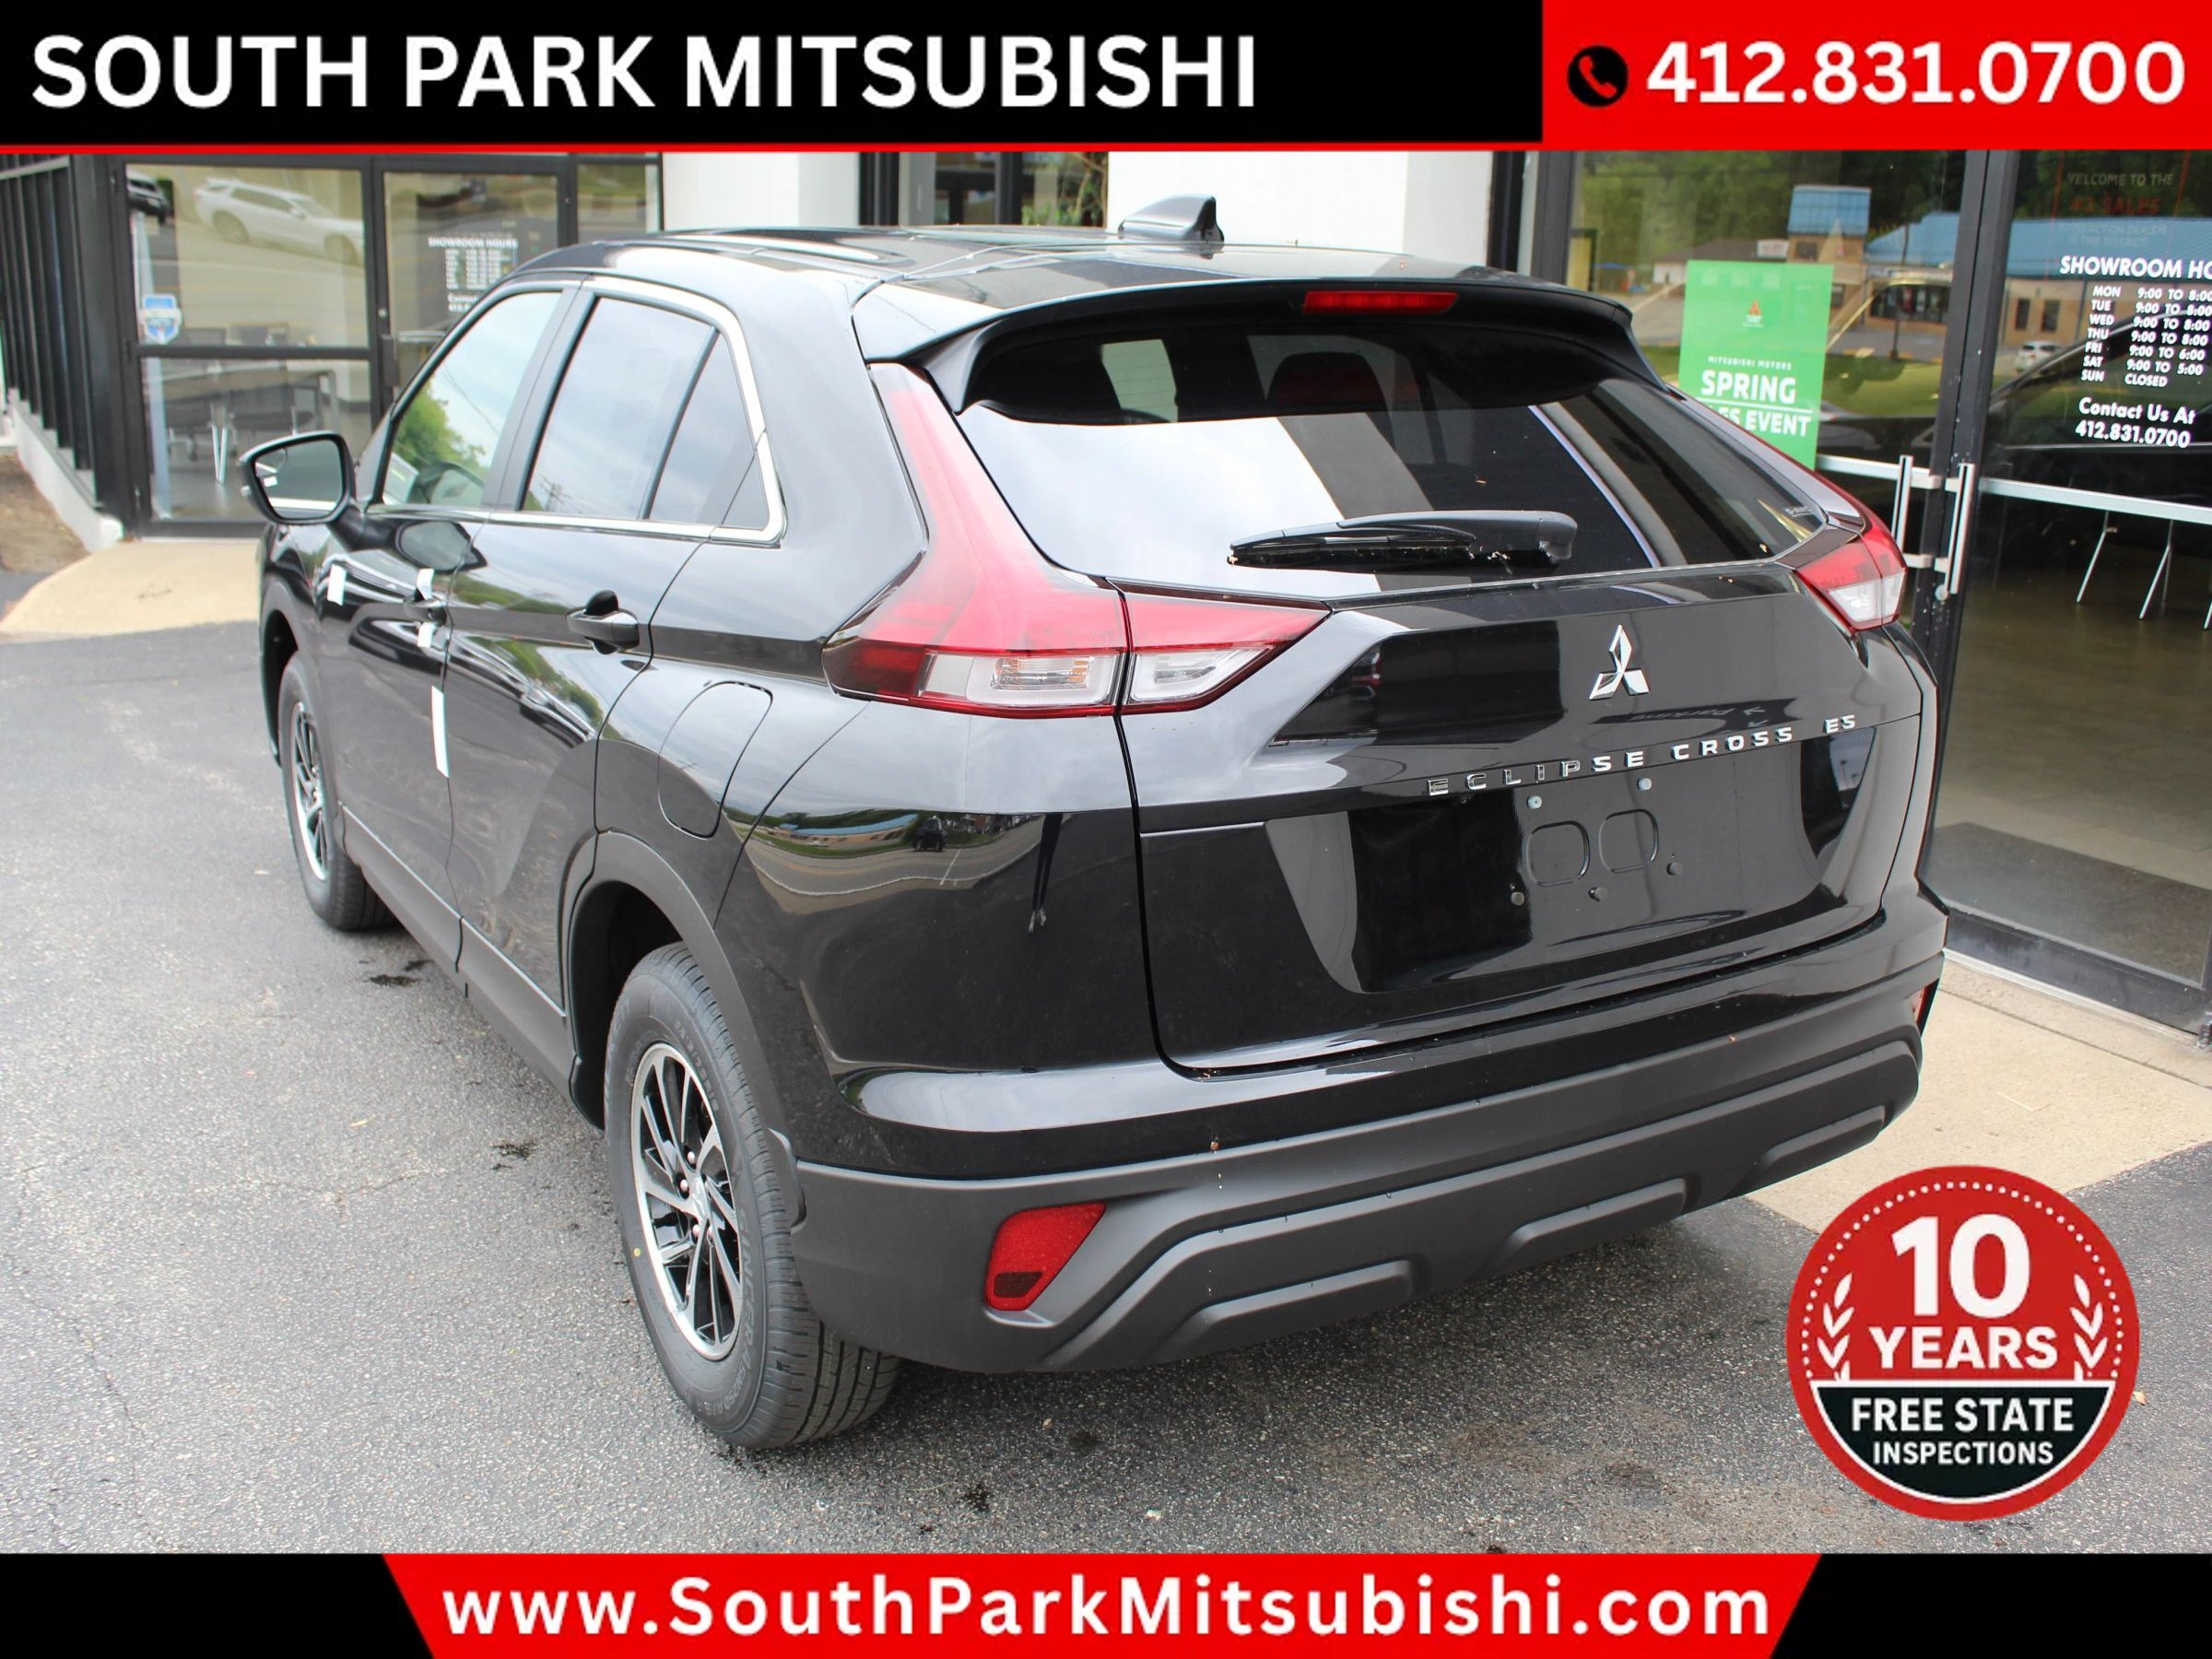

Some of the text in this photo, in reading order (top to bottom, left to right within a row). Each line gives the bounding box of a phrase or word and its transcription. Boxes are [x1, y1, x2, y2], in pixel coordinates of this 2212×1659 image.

[2059, 255, 2183, 278] SHOWROOM
[2093, 286, 2121, 297] MON
[2137, 288, 2162, 300] 9:00
[2168, 288, 2183, 300] TO
[2091, 300, 2112, 312] TUE
[2136, 302, 2159, 313] 9:00
[2165, 304, 2181, 315] TO
[2089, 314, 2210, 332] WED 9:00 TO 8:00
[2087, 328, 2208, 347] THU 9:00 TO 8:00
[2085, 341, 2206, 360] FRI 9:00 TO 6:00
[1708, 356, 1792, 371] MITSUBISHI MOTORS
[2083, 356, 2204, 375] SAT 9:00 TO 5:00
[1700, 369, 1796, 404] SPRING
[2081, 370, 2168, 387] SUN CLOSED
[2078, 396, 2195, 424] Contact Us At
[1745, 410, 1811, 437] EVENT
[2075, 420, 2191, 448] 412.831.0700
[1427, 714, 1856, 796] ECLIPSE CROSS ES
